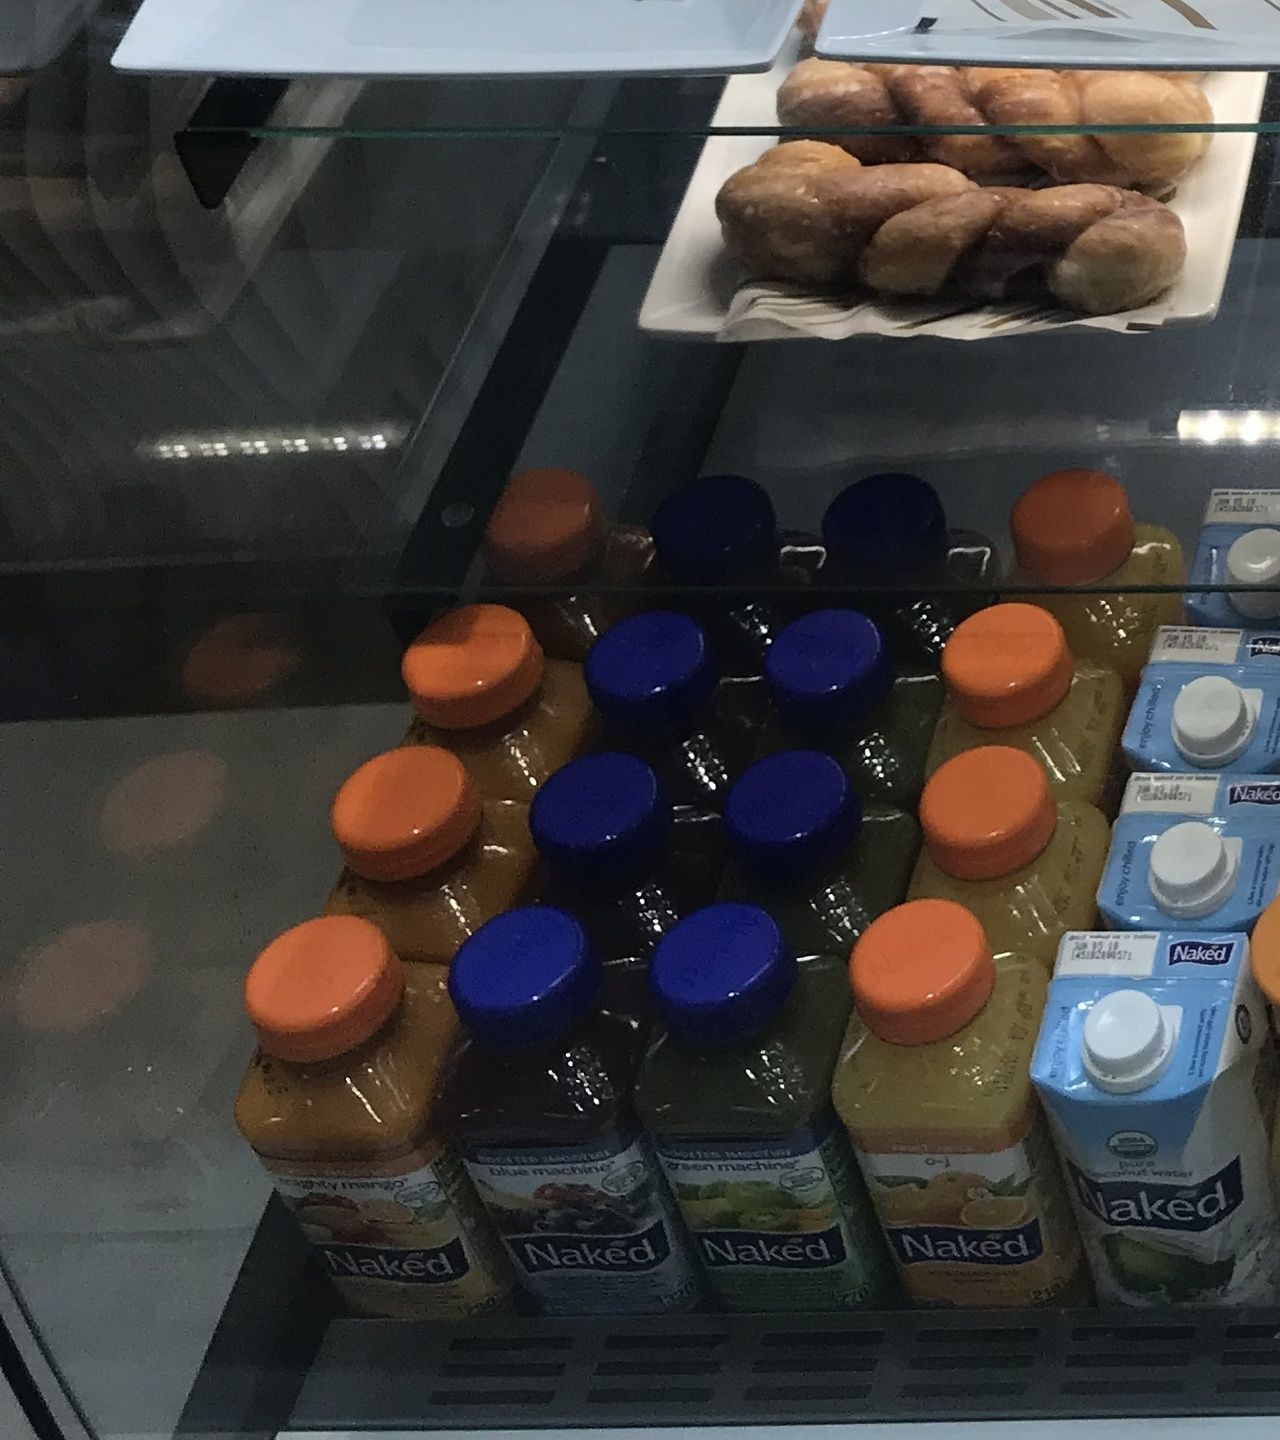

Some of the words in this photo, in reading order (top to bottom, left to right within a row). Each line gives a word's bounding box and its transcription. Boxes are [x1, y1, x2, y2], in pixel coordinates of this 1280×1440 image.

[1115, 879, 1130, 906] enjoy
[1123, 840, 1137, 877] chilled
[1172, 944, 1228, 962] Naked
[489, 1165, 530, 1177] blue
[532, 1162, 611, 1176] machine
[717, 1161, 795, 1172] machine
[1079, 1179, 1228, 1223] Naked
[523, 1237, 657, 1267] Naked
[701, 1237, 833, 1263] Naked
[899, 1231, 1030, 1259] Naked
[323, 1248, 454, 1278] Naked
